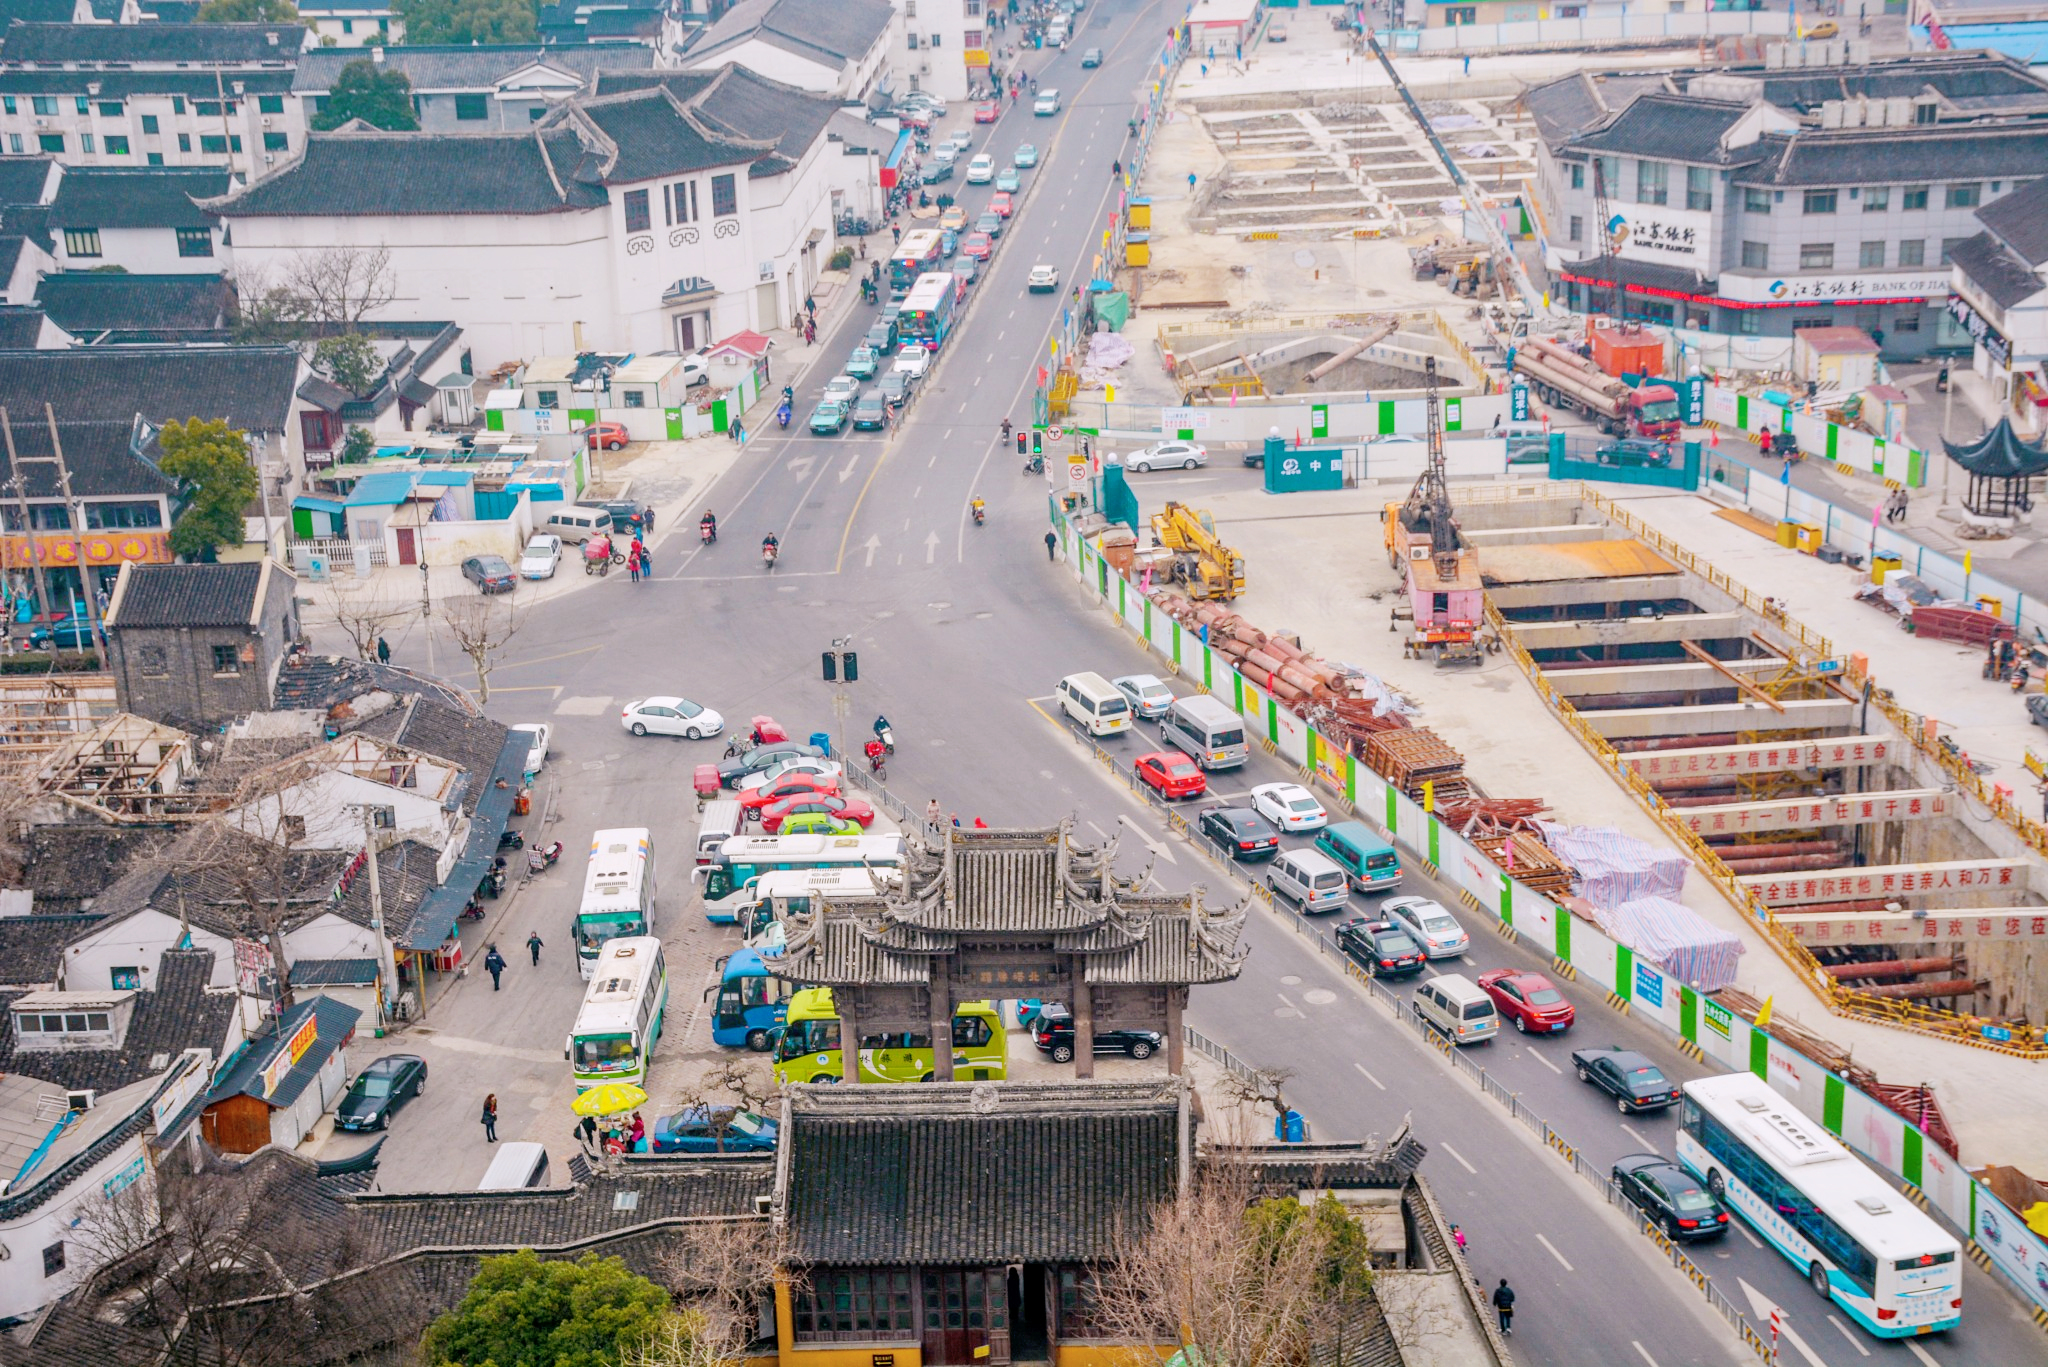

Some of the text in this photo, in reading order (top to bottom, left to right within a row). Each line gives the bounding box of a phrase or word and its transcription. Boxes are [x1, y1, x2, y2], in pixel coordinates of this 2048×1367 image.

[1633, 221, 1695, 245] 江苏银行
[1793, 280, 1865, 296] 江苏银行
[1872, 280, 1906, 292] BANK
[1909, 280, 1925, 290] OF
